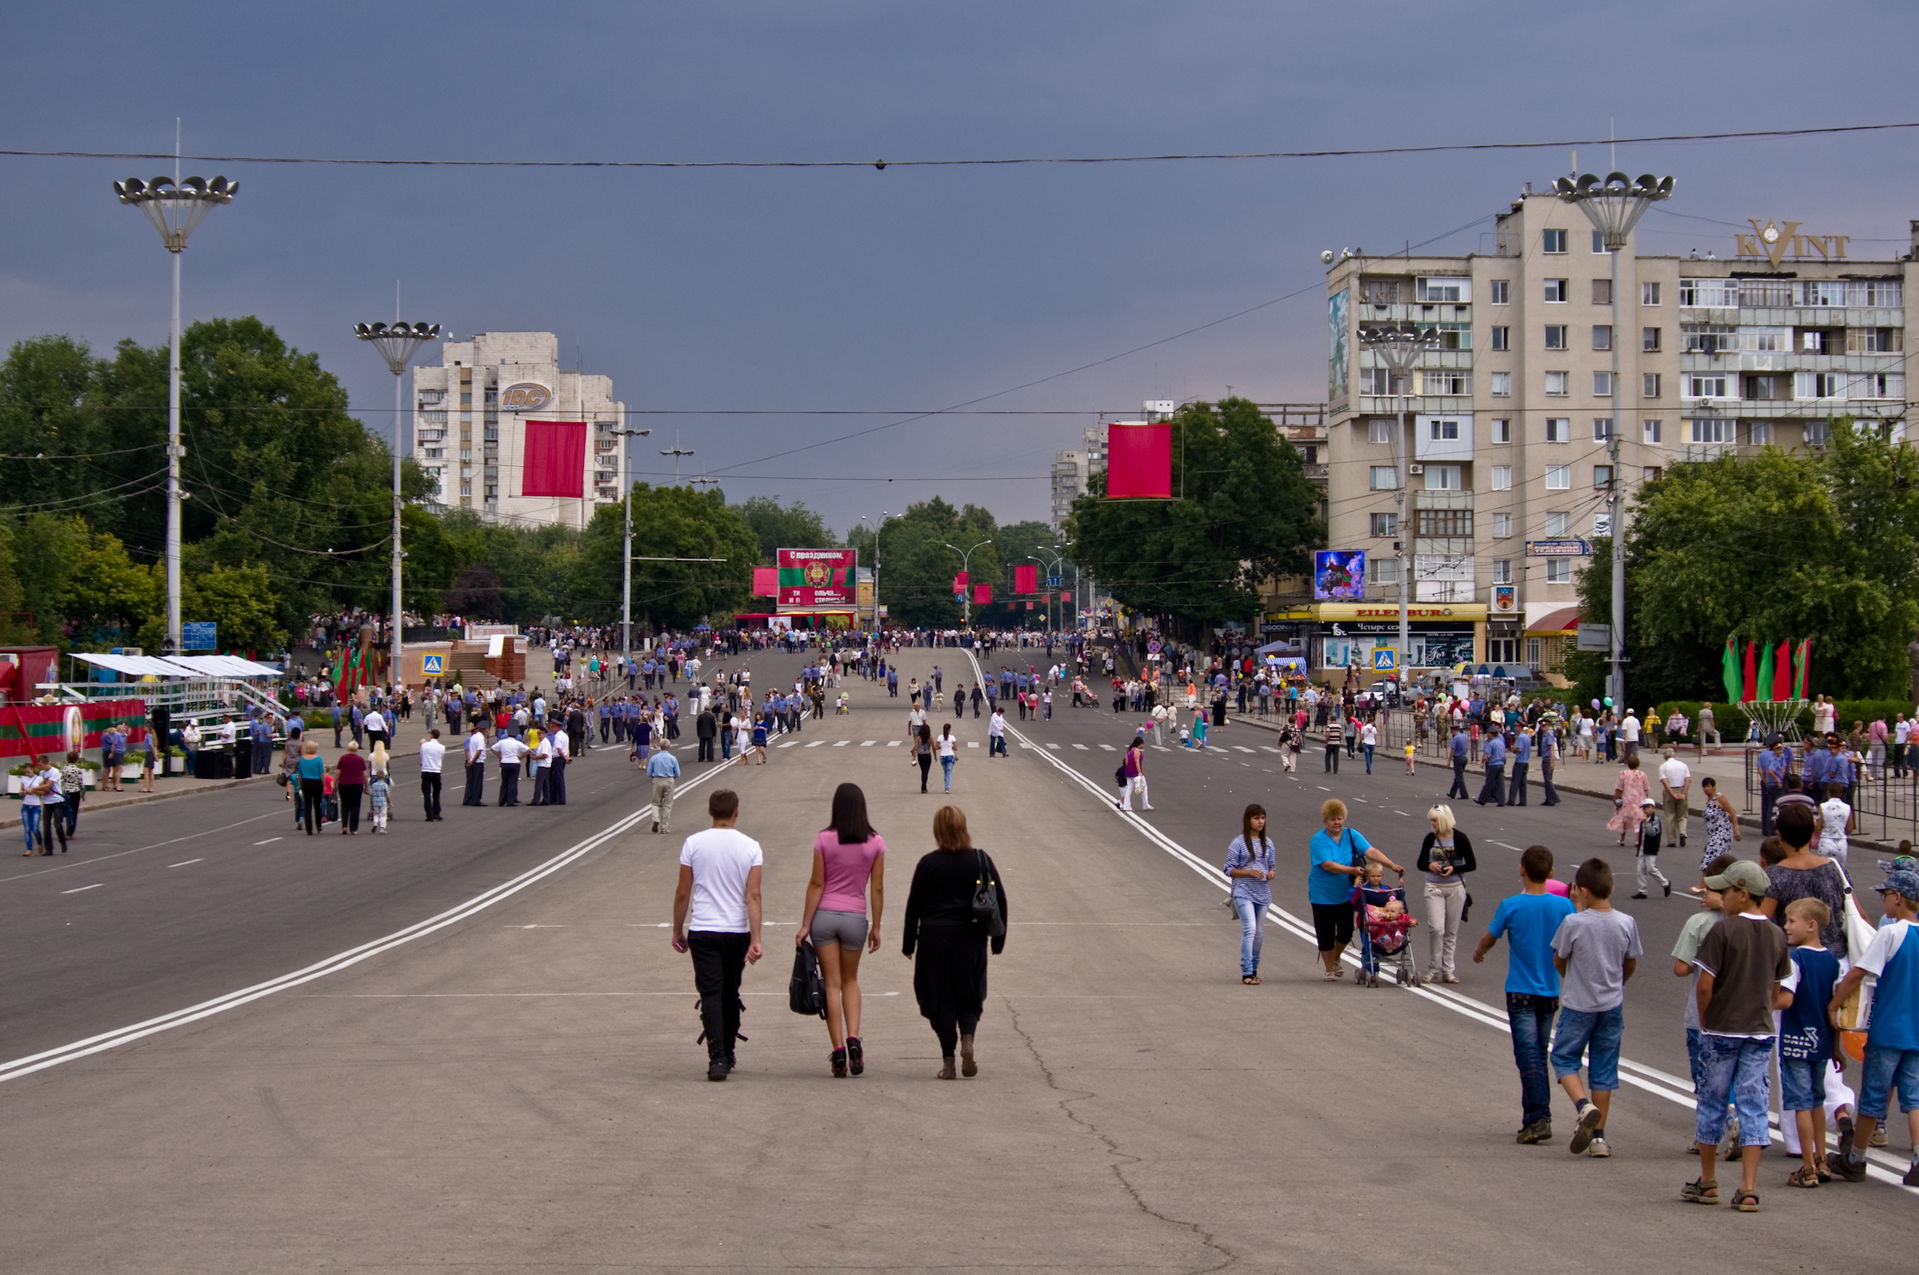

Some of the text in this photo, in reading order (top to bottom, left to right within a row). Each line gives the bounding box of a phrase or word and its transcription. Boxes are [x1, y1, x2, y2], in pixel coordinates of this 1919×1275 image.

[1734, 217, 1851, 269] KVINT
[503, 390, 542, 405] IDC
[1357, 623, 1385, 632] Четыре
